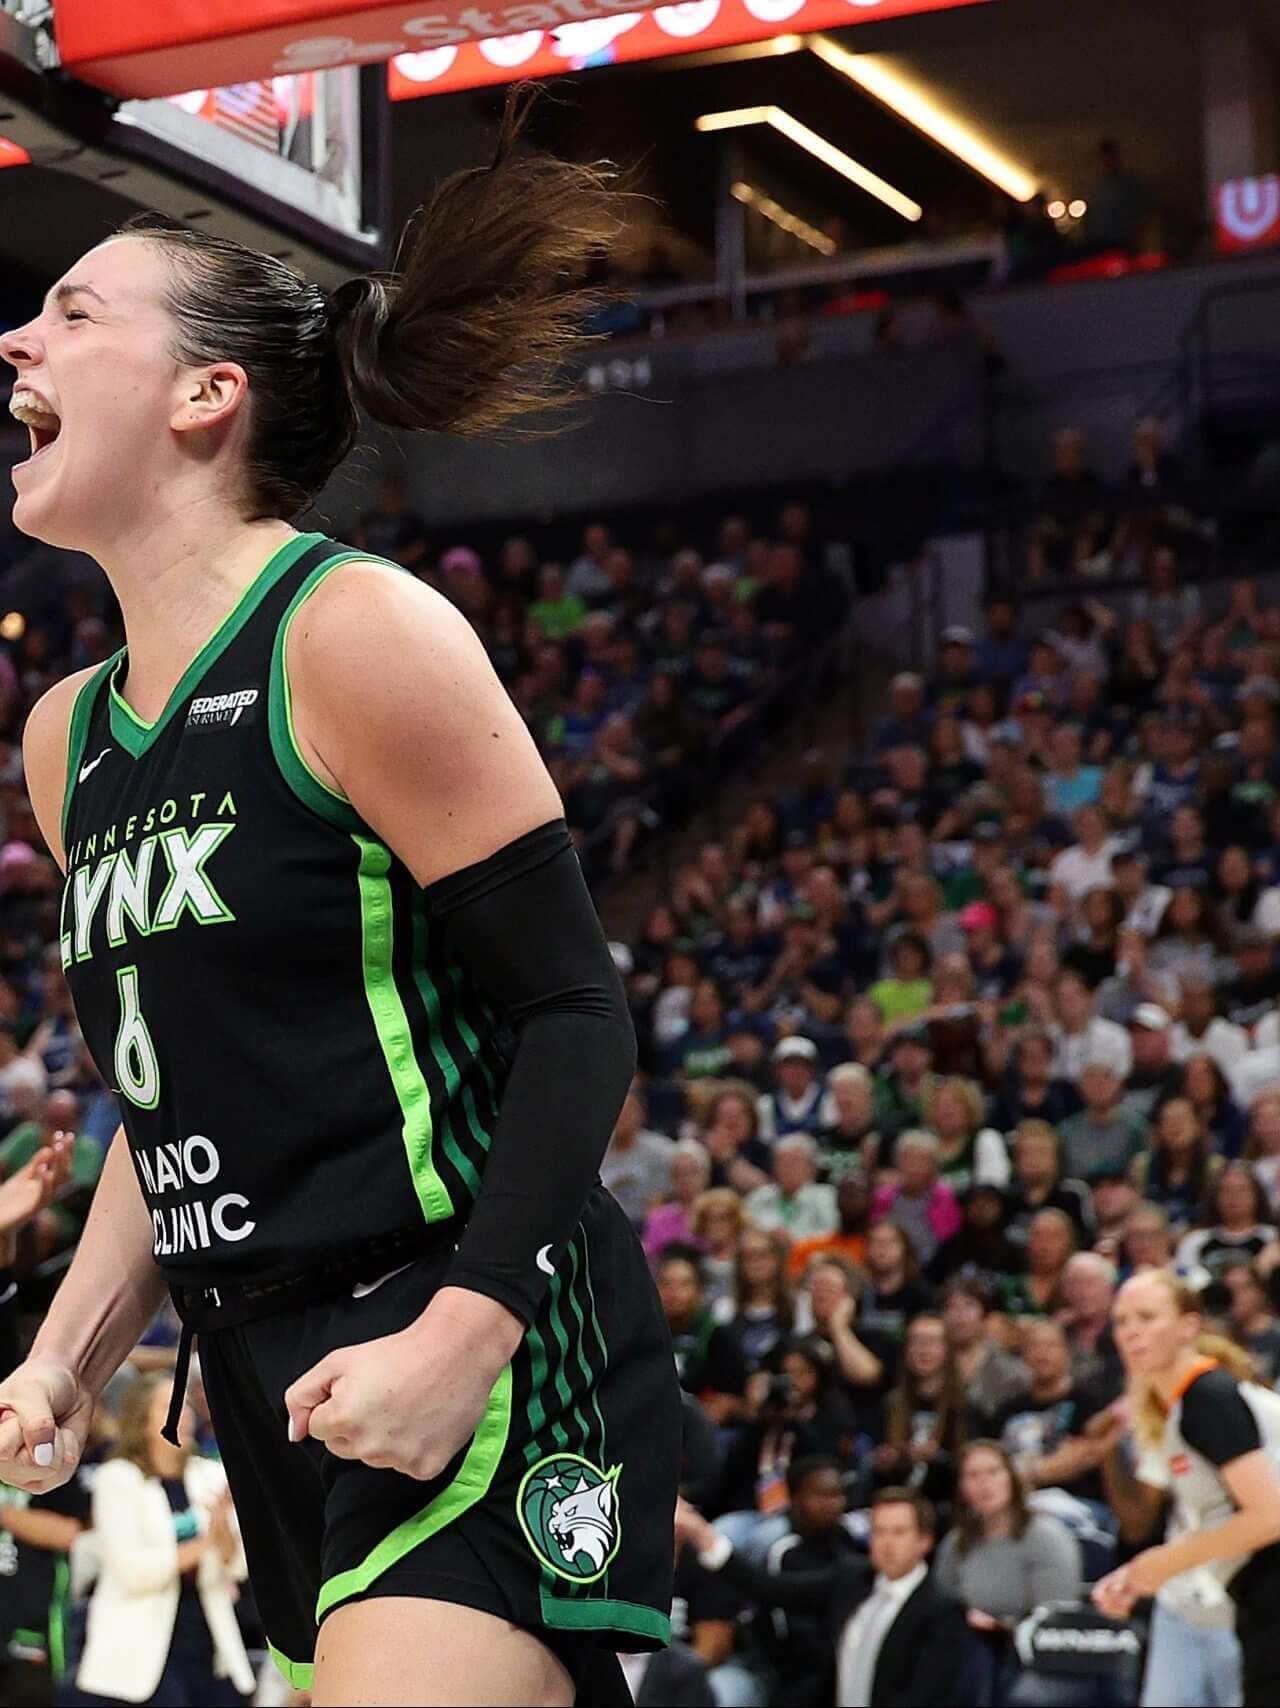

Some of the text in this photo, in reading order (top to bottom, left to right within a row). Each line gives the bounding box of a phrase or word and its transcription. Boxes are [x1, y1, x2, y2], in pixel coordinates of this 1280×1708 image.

[188, 689, 259, 716] FEDERATED
[115, 965, 160, 1110] 6
[152, 1193, 256, 1256] CLINIC
